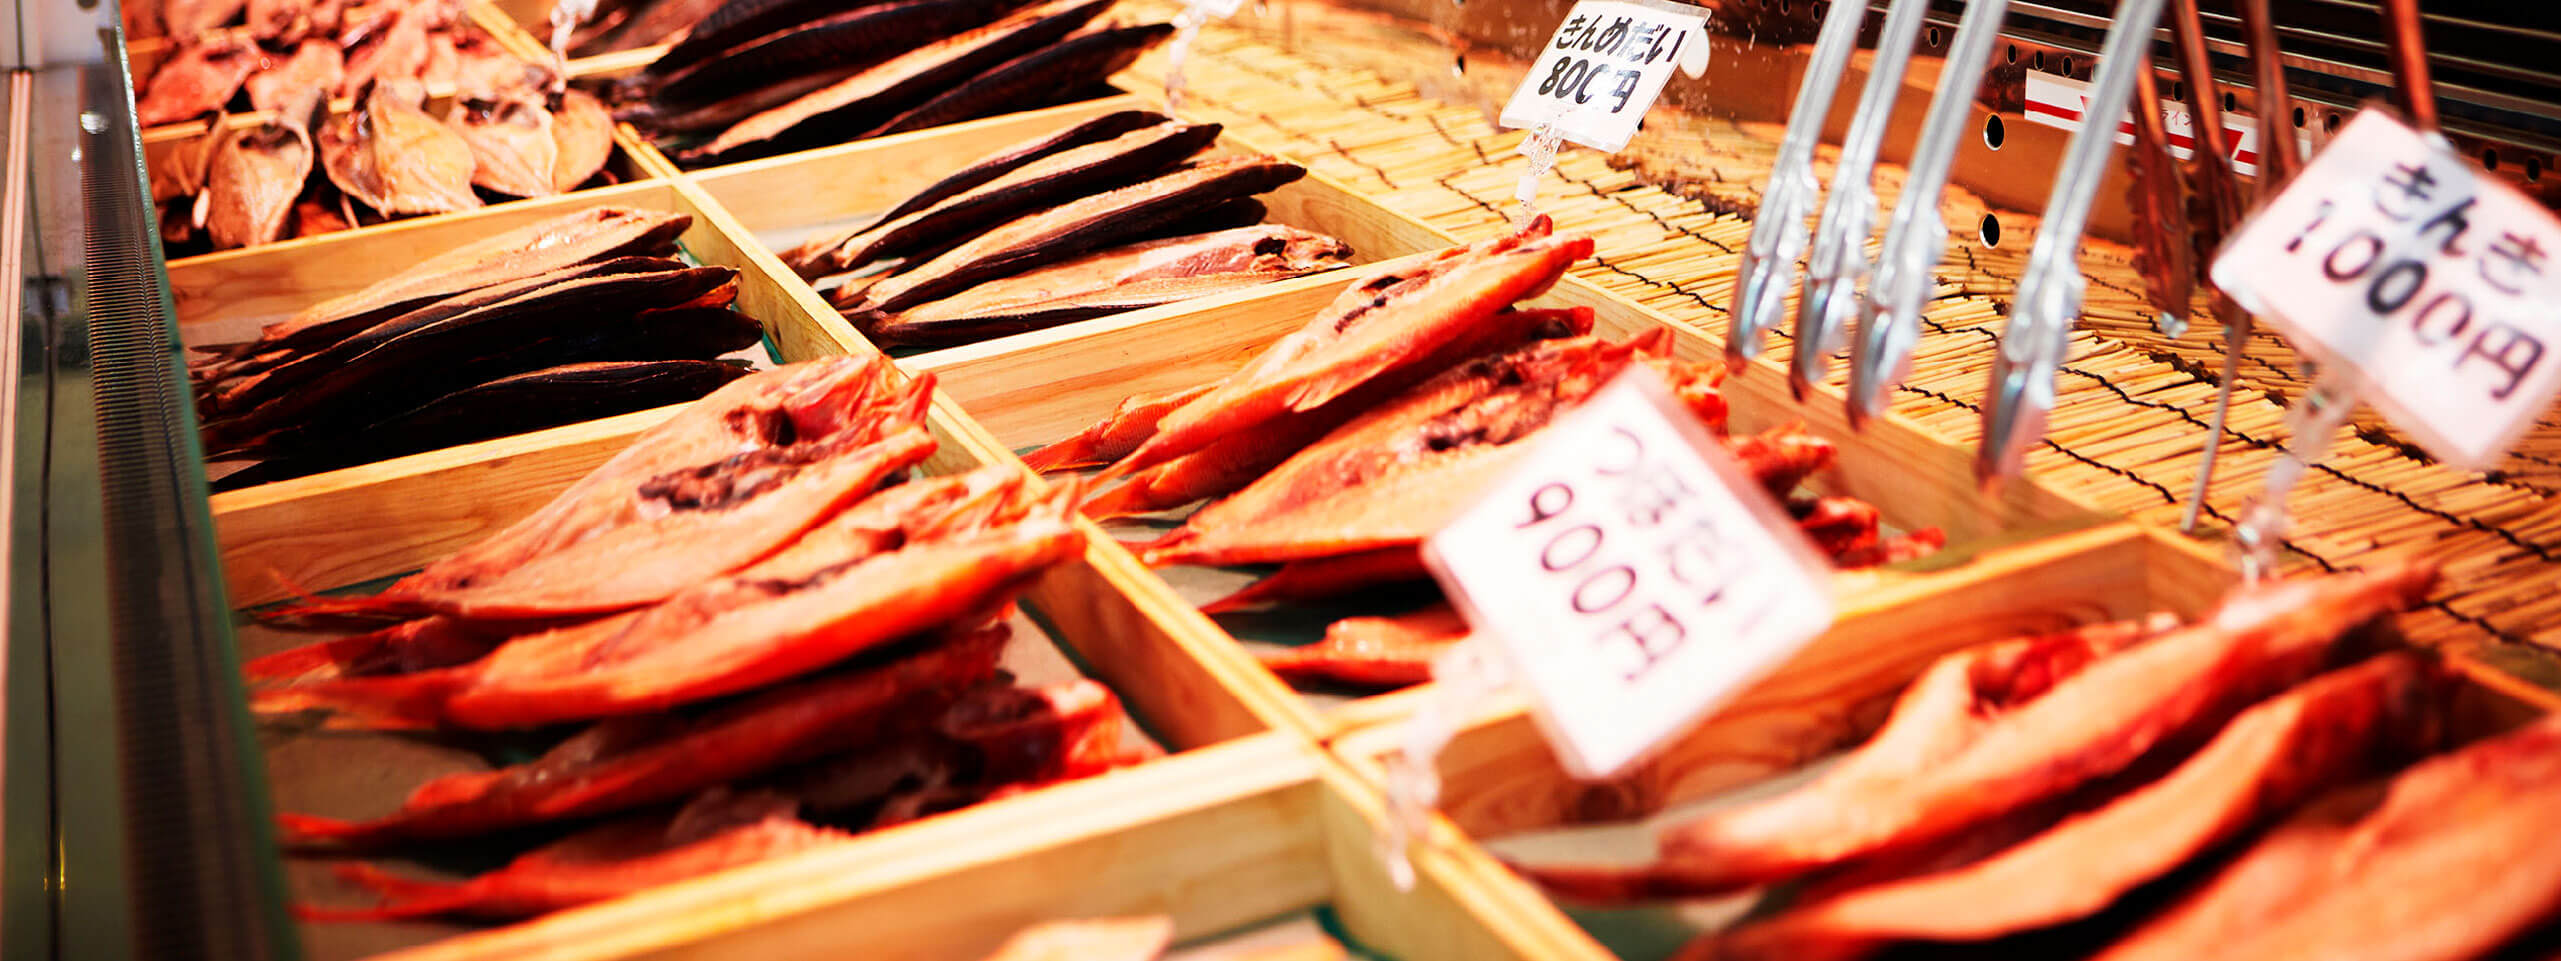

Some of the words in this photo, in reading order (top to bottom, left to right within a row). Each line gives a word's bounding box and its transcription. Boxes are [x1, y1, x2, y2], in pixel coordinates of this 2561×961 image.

[1538, 56, 1641, 113] 800円
[1556, 14, 1686, 65] きんめだい
[2373, 161, 2547, 296] きんき
[2284, 199, 2546, 400] 1000円
[1512, 481, 1688, 682] 900円
